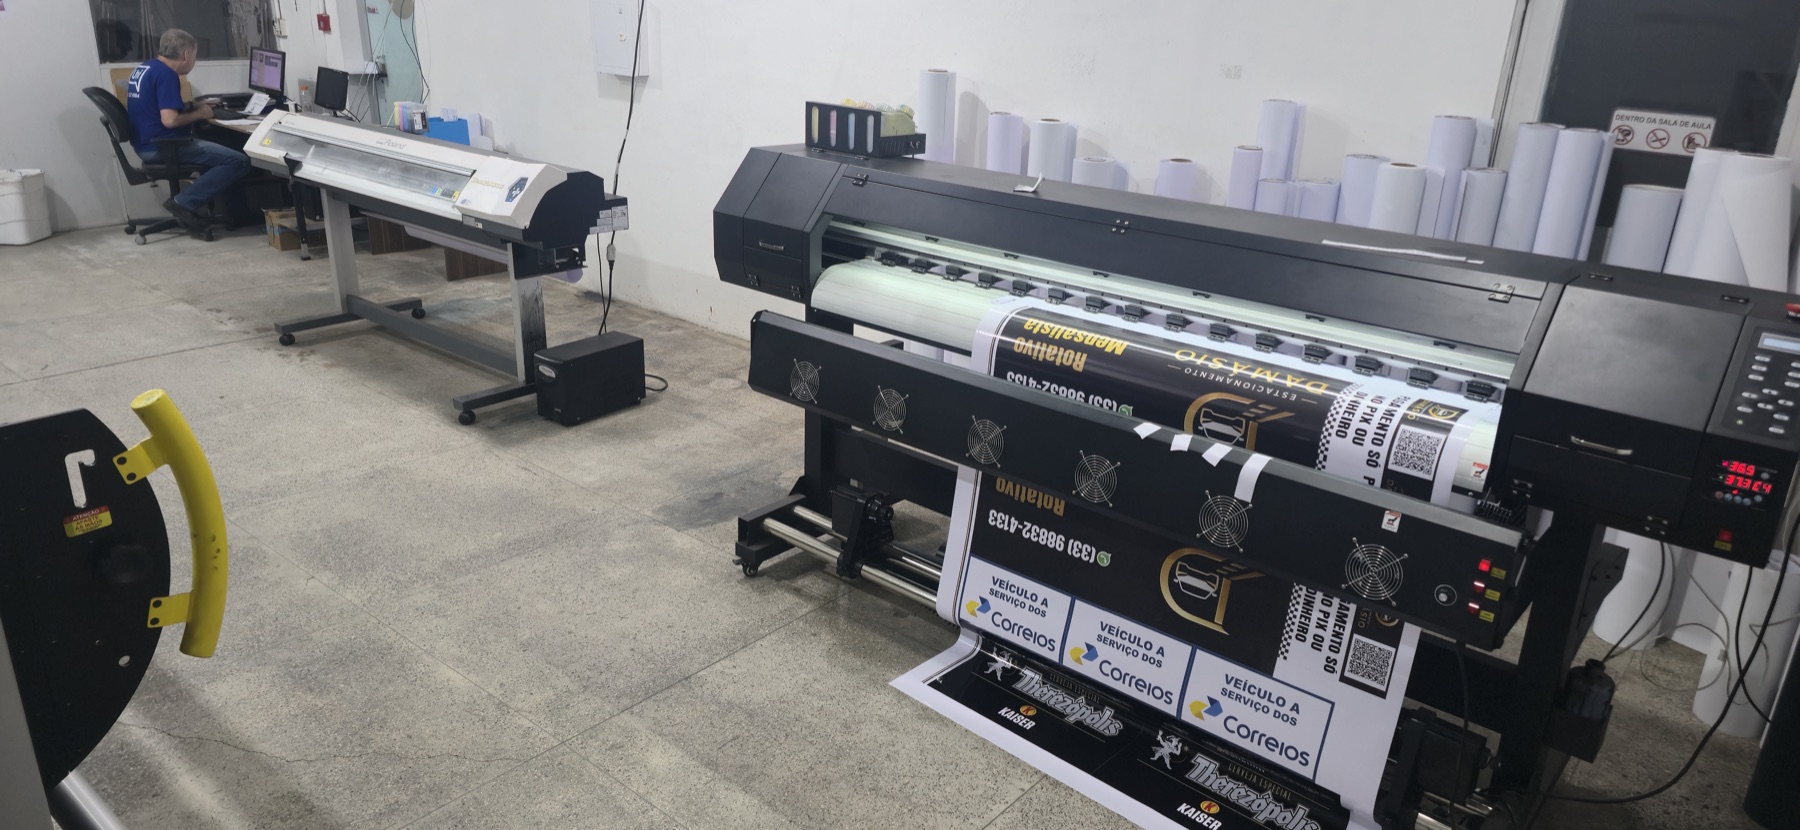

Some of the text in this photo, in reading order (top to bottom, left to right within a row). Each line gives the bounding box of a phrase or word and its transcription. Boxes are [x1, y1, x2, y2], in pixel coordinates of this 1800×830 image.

[1615, 114, 1711, 130] DENTRO DA SALA DE AULA
[1013, 336, 1088, 372] Rotativo
[1023, 318, 1130, 356] Mensalista
[1184, 367, 1297, 401] ESTACIONAMENTO
[1359, 404, 1378, 425] PIX
[1352, 428, 1367, 447] OU
[995, 477, 1066, 517] Rotativo
[988, 509, 1096, 563] (33) 98832-4133
[989, 588, 1047, 618] SERVIÇO DOS
[992, 576, 1049, 608] VEÍCULO A
[991, 611, 1056, 652] Correios
[1315, 609, 1331, 632] PIX
[1096, 634, 1163, 668] SERVIÇO DOS
[1100, 621, 1165, 657] VEÍCULO A
[1311, 634, 1325, 652] OU
[1099, 659, 1174, 705] Correios
[1324, 656, 1338, 675] SÓ
[1012, 666, 1123, 737] Therezópolis
[1220, 687, 1298, 726] SERVIÇO DOS
[1225, 673, 1300, 715] VEÍCULO A
[998, 706, 1036, 730] KAISER
[1223, 715, 1310, 767] Correios
[1176, 802, 1223, 830] KAISER
